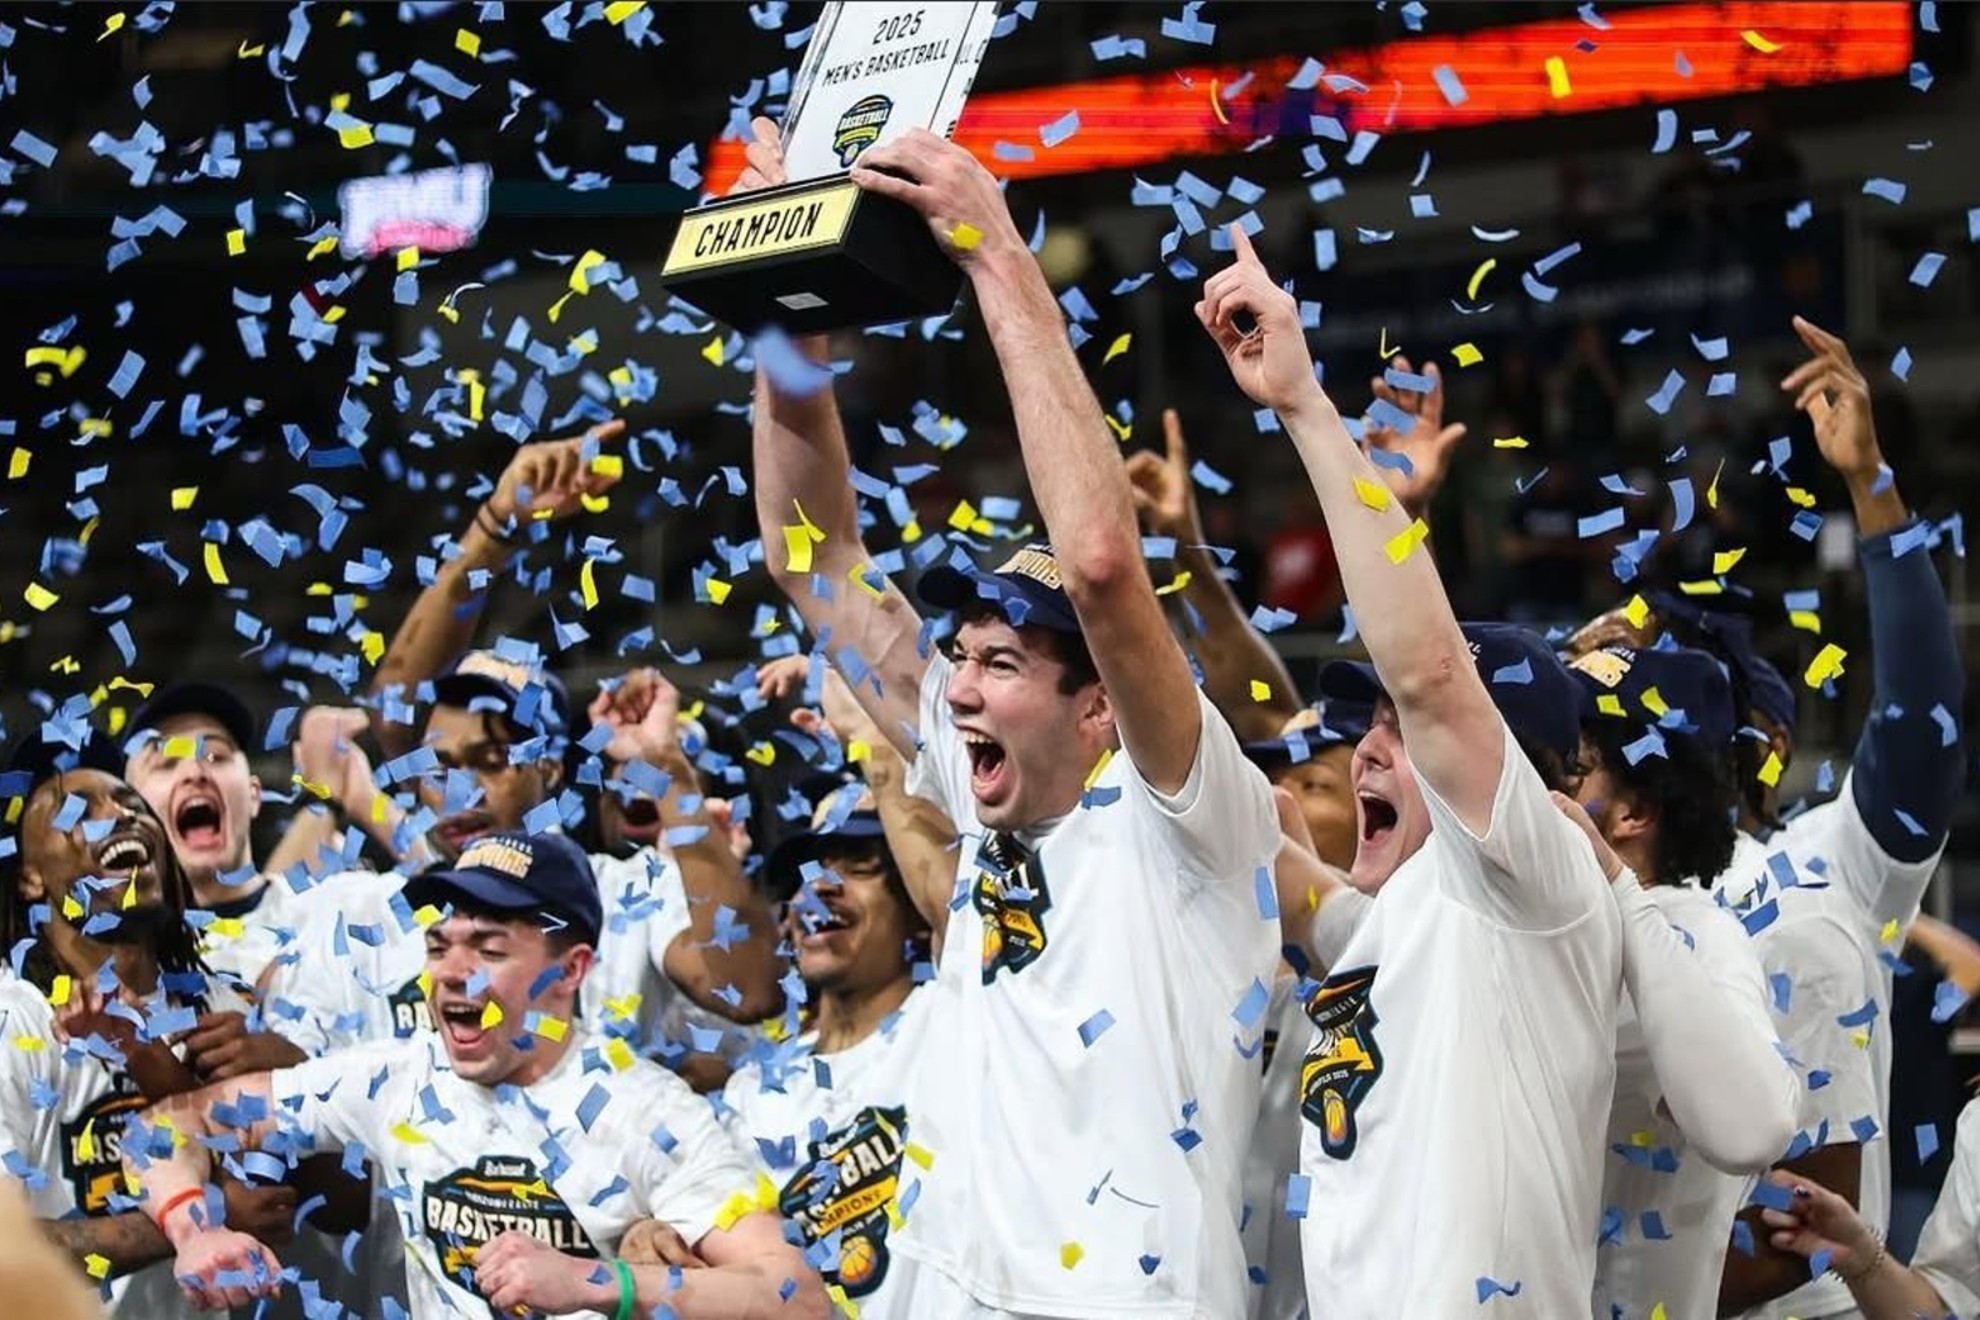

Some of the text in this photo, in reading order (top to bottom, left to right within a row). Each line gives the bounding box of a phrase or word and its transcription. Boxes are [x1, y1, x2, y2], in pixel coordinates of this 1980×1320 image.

[872, 9, 926, 45] 2025
[822, 60, 863, 87] MEN'S
[865, 38, 949, 77] BASKETBALL
[695, 202, 823, 258] CHAMPION
